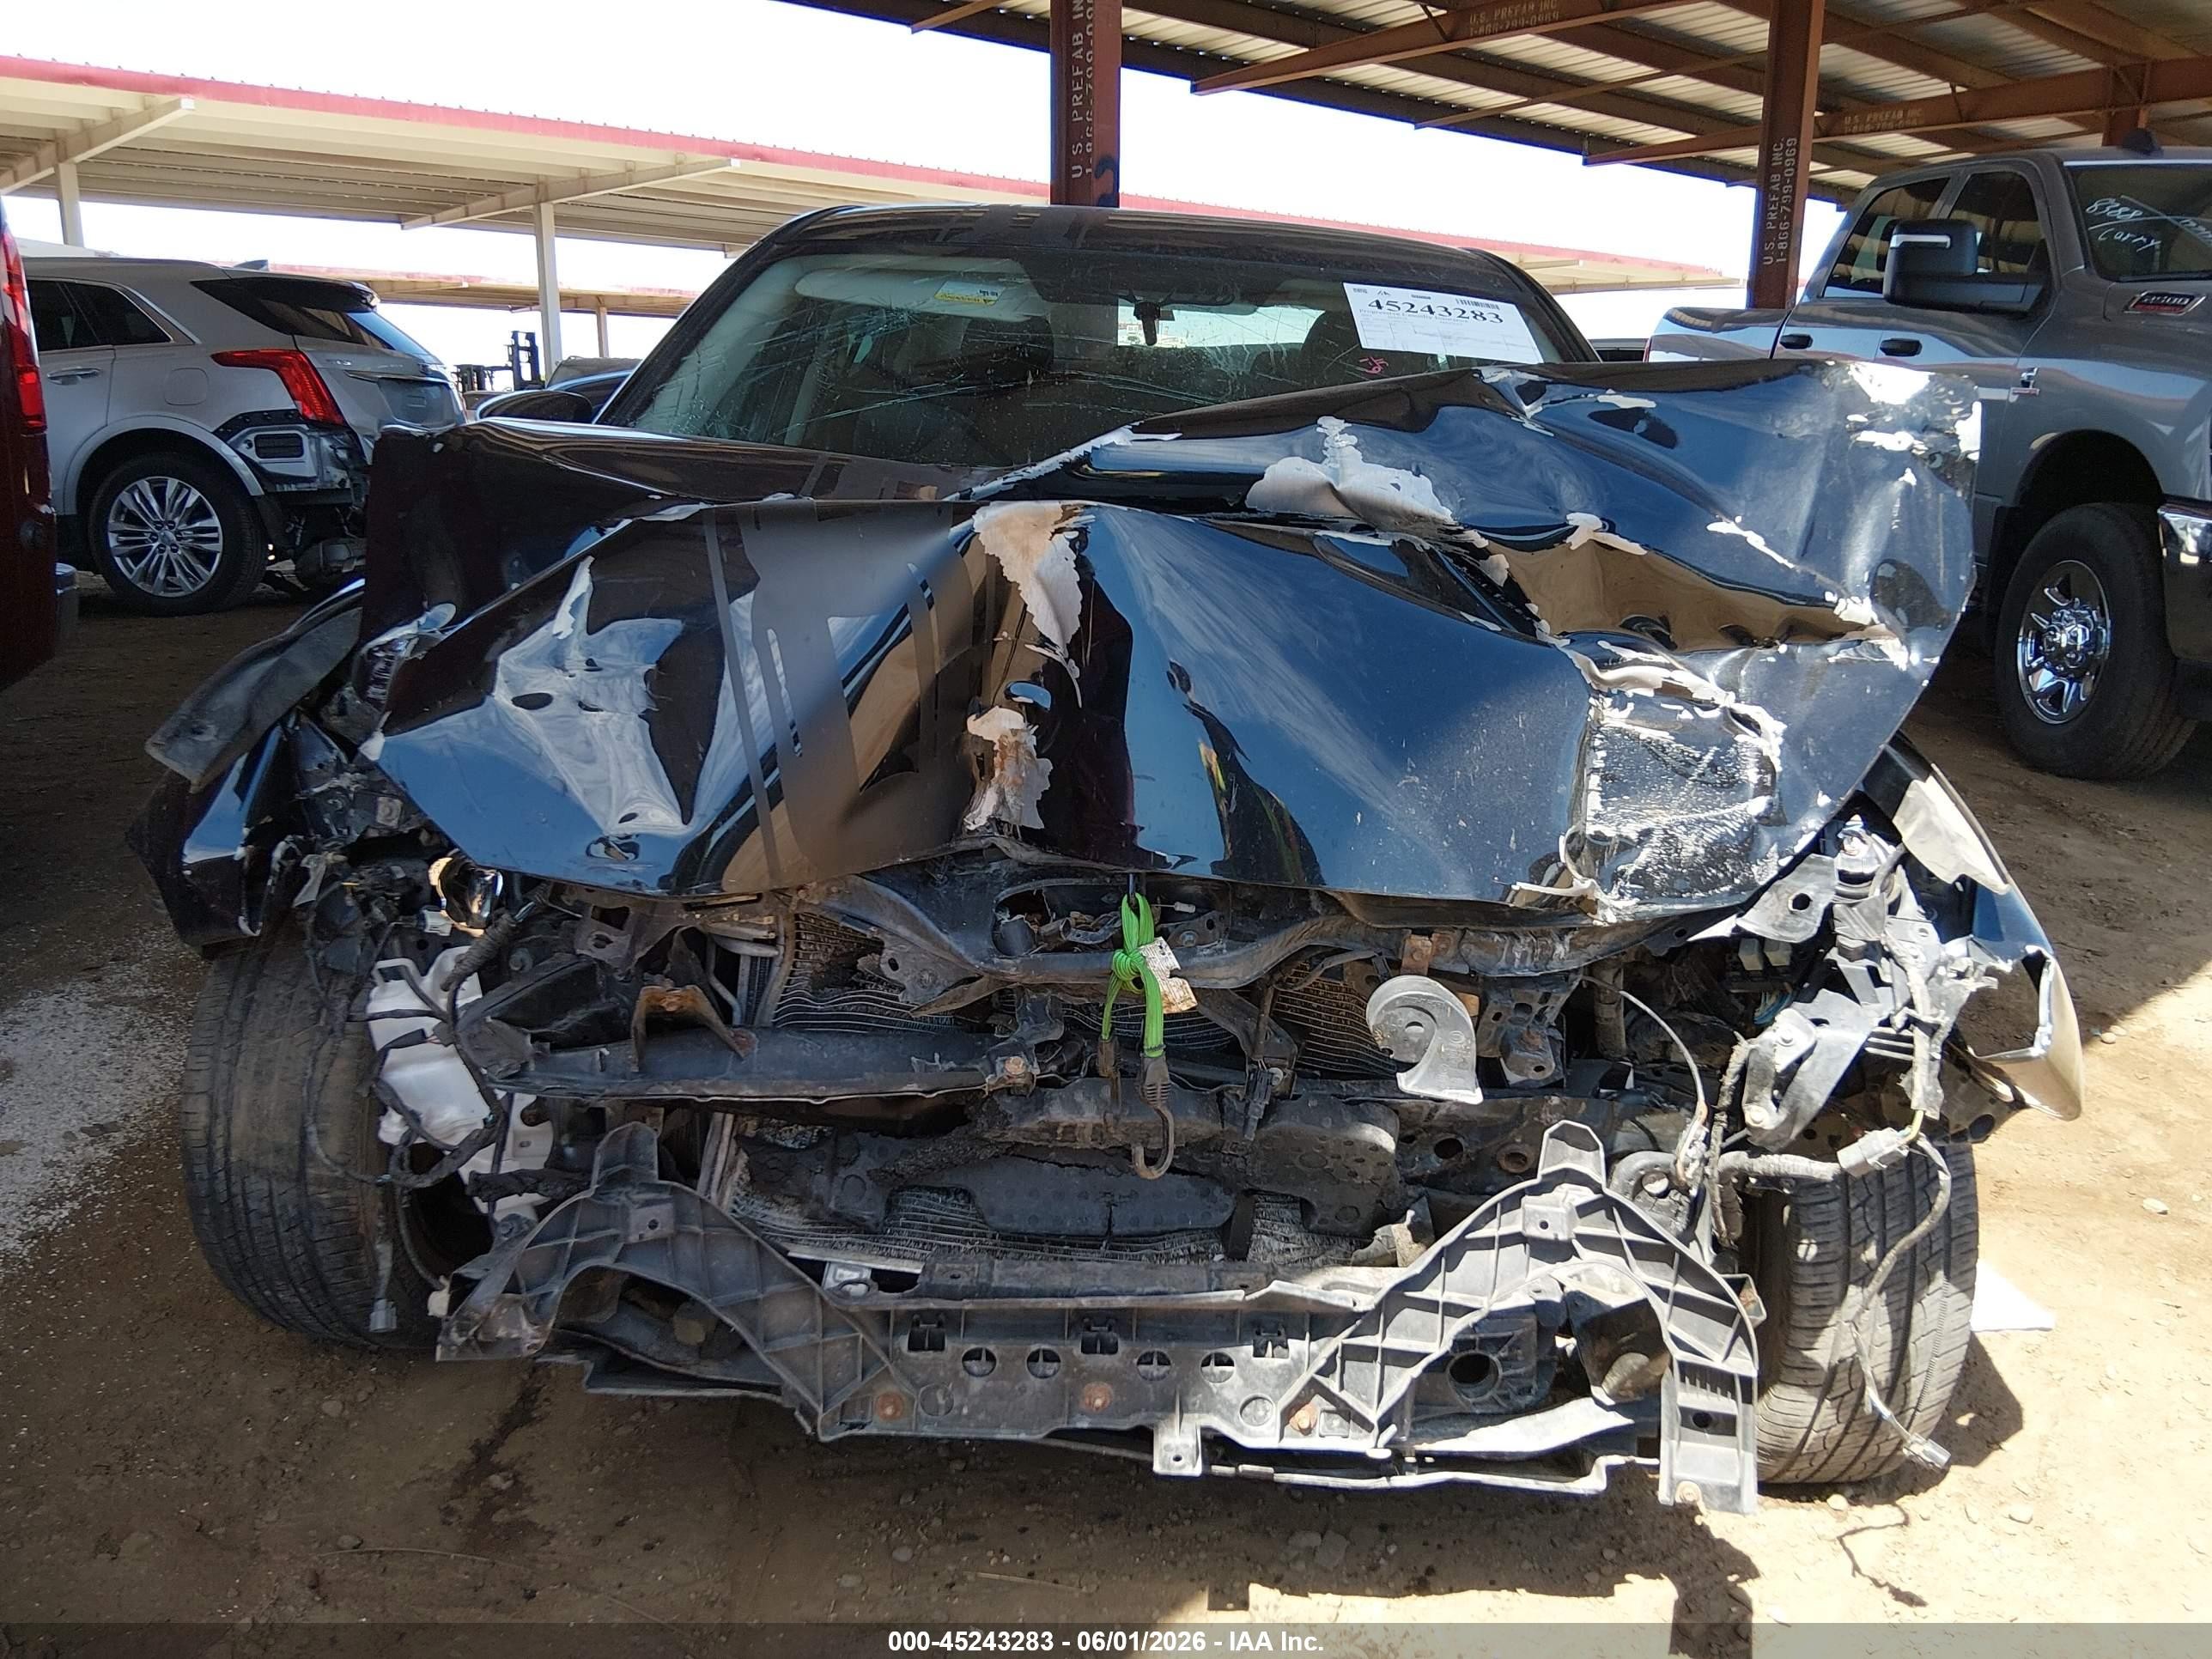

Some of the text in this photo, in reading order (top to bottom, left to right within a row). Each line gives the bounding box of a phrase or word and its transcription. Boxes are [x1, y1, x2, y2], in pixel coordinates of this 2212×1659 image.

[1072, 32, 1084, 122] PREFAB
[1072, 135, 1084, 179] U.S.
[1765, 173, 1782, 230] PREFAB
[1776, 137, 1798, 263] 1-866-799-0969
[1763, 237, 1776, 265] U.S.
[1368, 298, 1504, 324] 45243283
